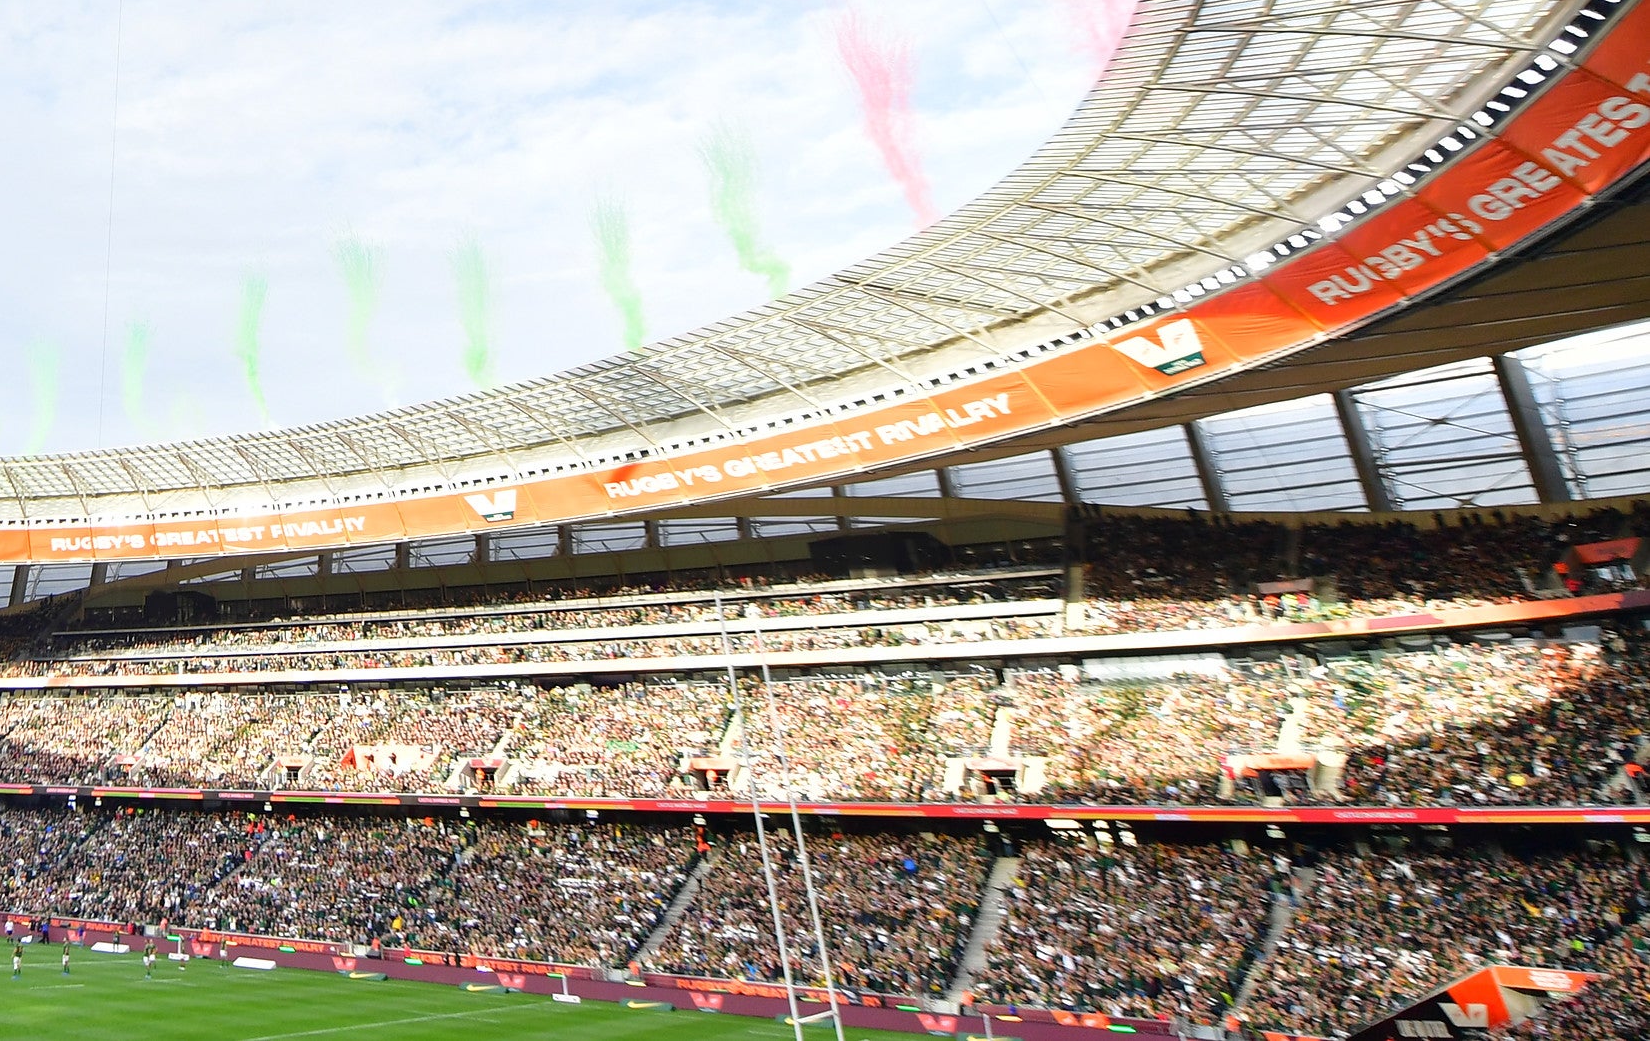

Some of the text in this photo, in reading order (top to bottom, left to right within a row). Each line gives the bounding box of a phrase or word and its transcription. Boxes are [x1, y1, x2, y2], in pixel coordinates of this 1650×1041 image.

[1306, 212, 1484, 306] RUGBY'S
[603, 391, 1013, 500] RUGBY'S GREATEST RIVALRY
[51, 515, 366, 551] RUGBY'S GREATEST RIVALRY
